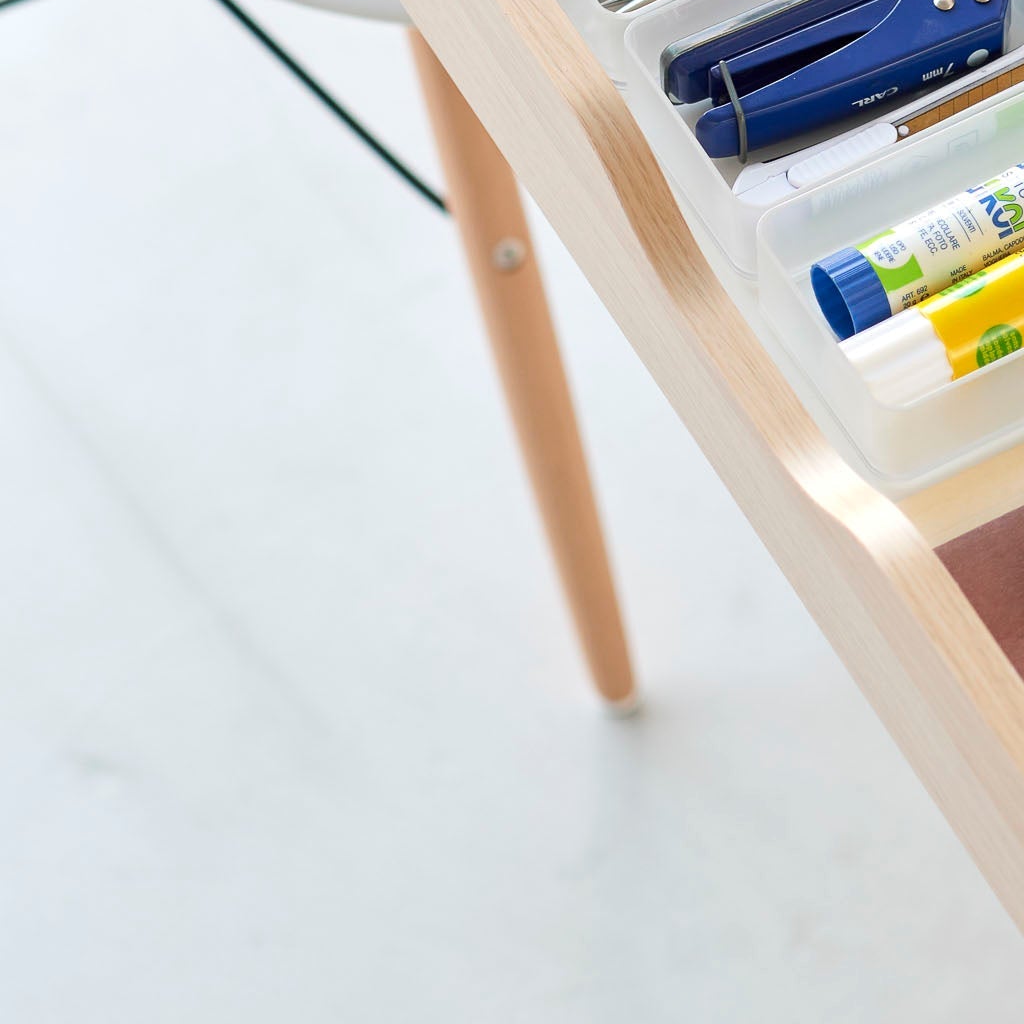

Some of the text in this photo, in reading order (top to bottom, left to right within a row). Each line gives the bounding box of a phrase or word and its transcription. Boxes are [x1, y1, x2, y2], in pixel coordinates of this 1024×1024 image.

[851, 86, 899, 108] CARL
[934, 231, 949, 251] FOTO
[950, 264, 967, 278] MADE
[901, 285, 928, 304] ART. 692
